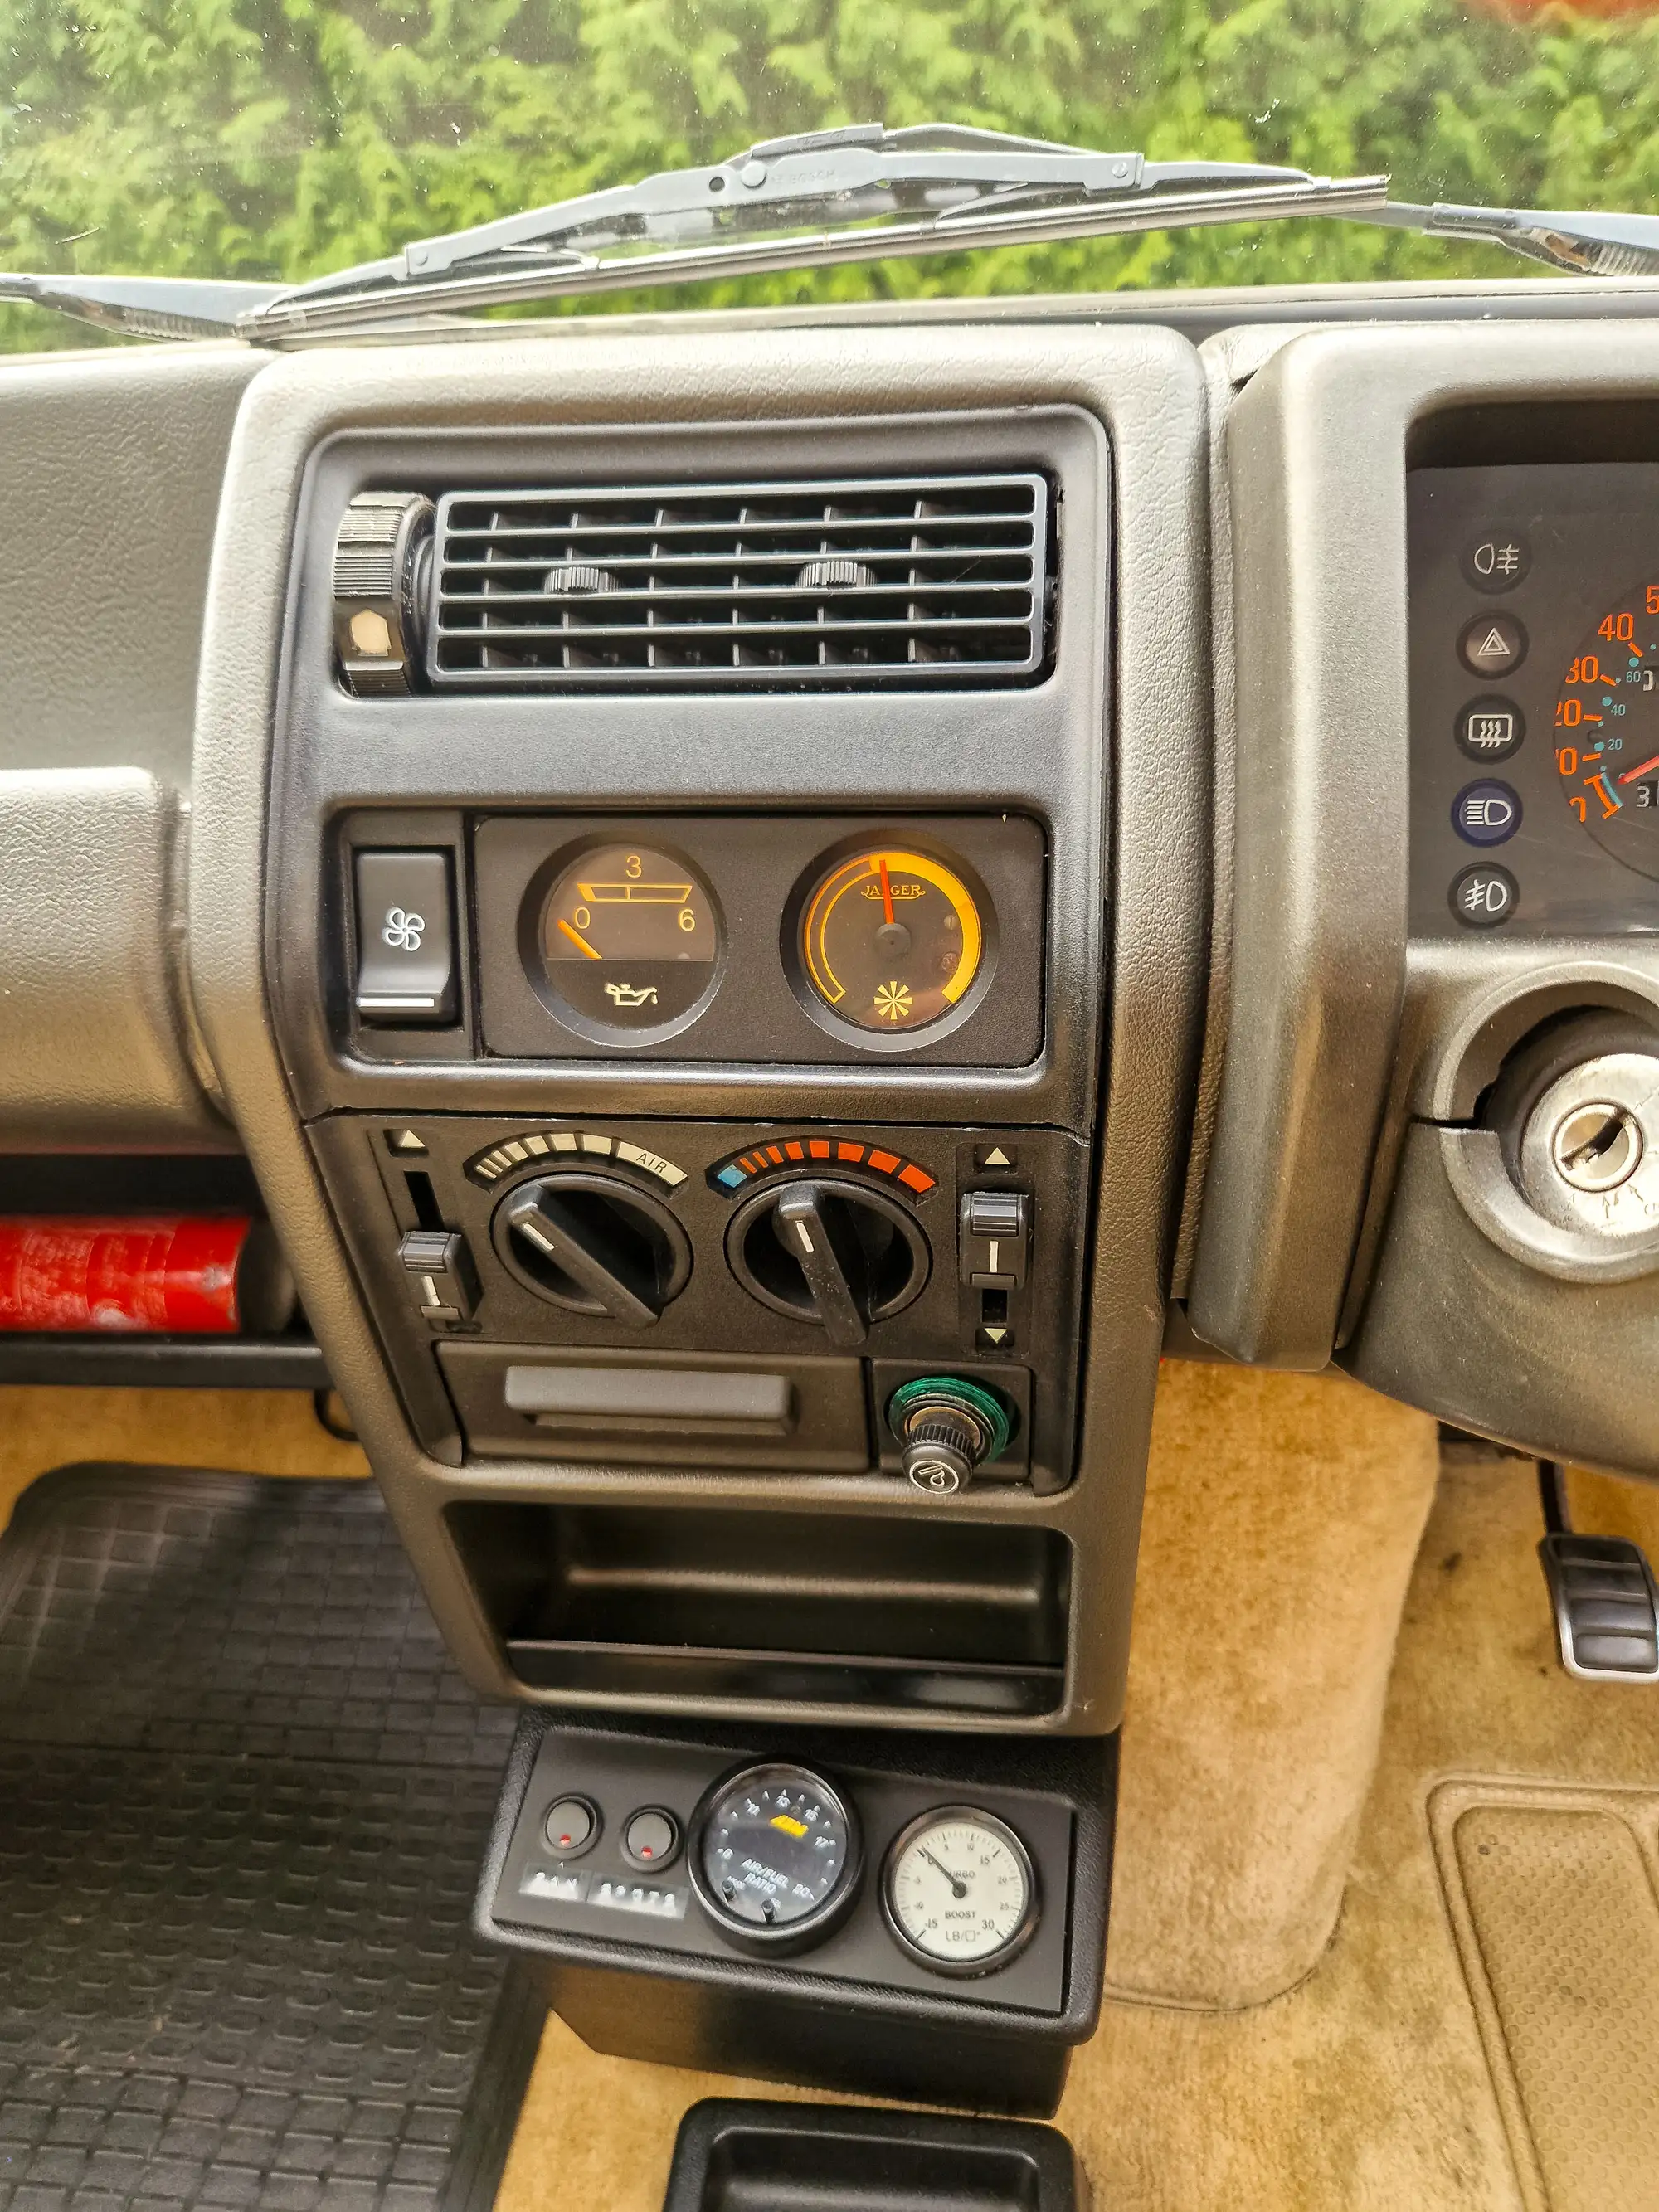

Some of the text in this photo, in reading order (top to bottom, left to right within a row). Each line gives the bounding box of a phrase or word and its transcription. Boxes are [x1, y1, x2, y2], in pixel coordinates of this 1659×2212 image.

[1598, 612, 1634, 641] 40
[1626, 670, 1641, 683] 60
[1610, 704, 1626, 716] 40
[1608, 738, 1623, 751] 20
[1554, 748, 1578, 775] 0
[625, 855, 642, 878] 3
[863, 885, 924, 897] JAGER
[574, 907, 591, 930] 0
[679, 908, 696, 931] 6
[636, 1152, 667, 1174] AIR
[980, 1855, 990, 1866] 15
[997, 1875, 1008, 1884] 20
[999, 1901, 1010, 1910] 25
[945, 1910, 976, 1919] BOOST
[981, 1919, 995, 1930] 30
